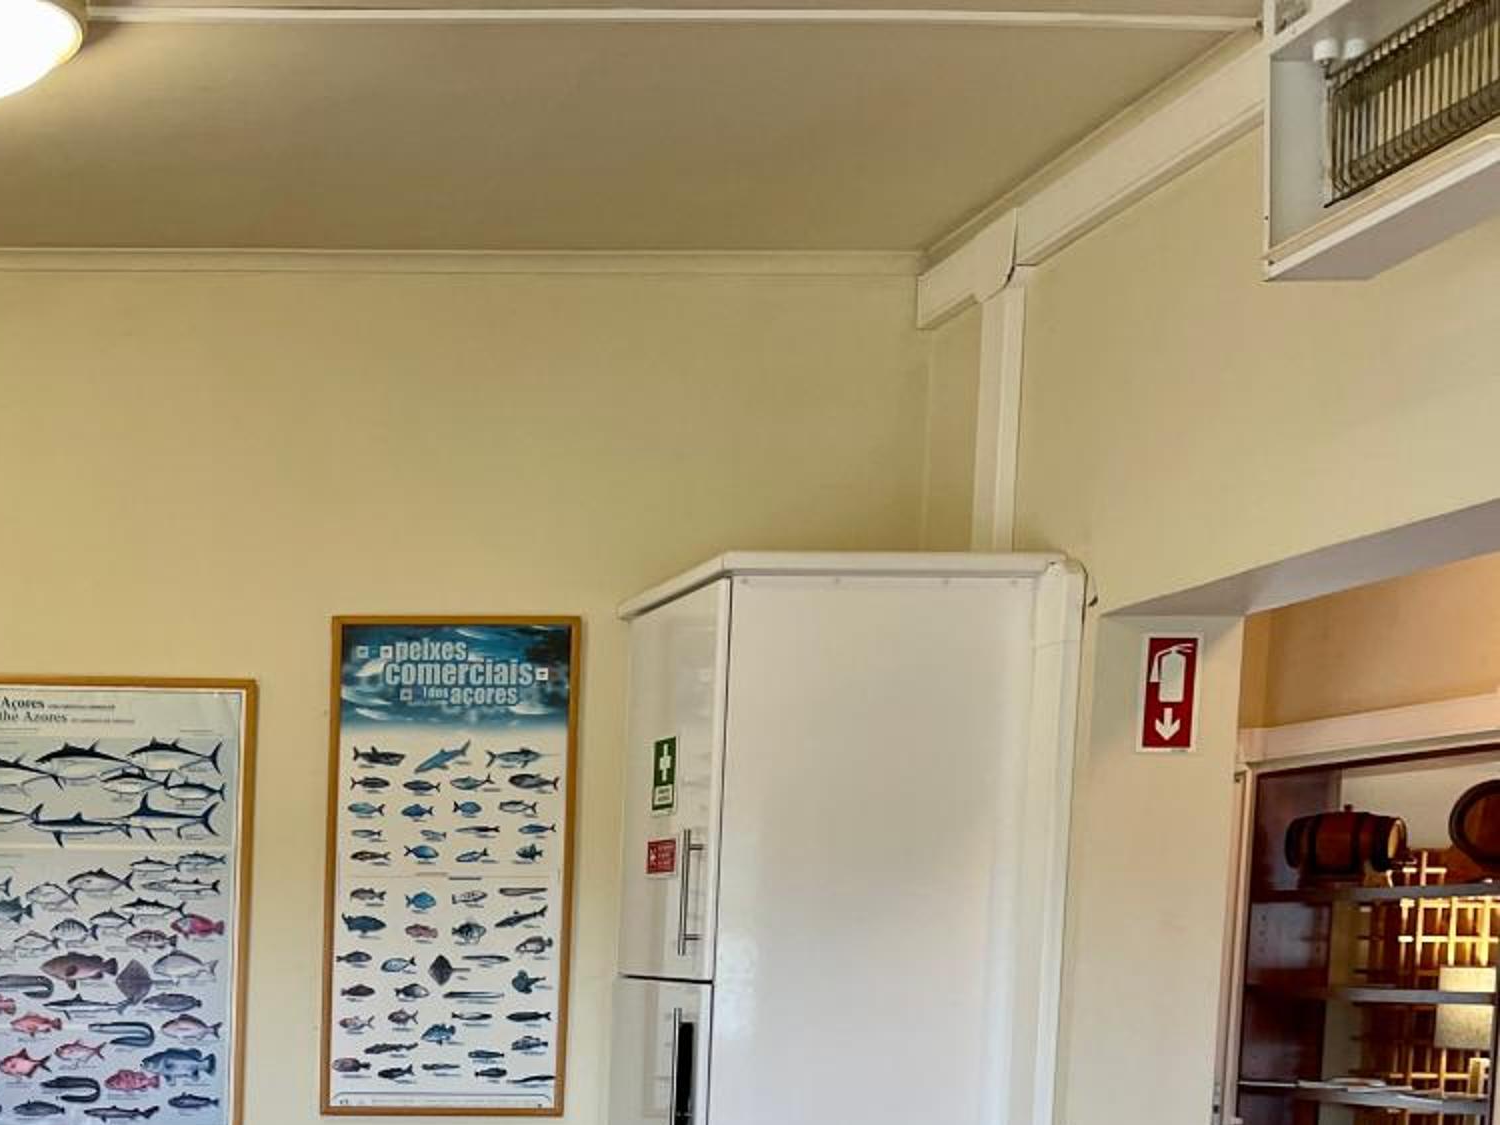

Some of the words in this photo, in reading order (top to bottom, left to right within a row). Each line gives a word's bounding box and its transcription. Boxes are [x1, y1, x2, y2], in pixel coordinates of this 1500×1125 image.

[395, 639, 468, 662] peixes
[385, 659, 533, 686] comerciais
[1, 695, 45, 711] Açores
[451, 687, 518, 706] açores
[24, 710, 68, 723] Azores
